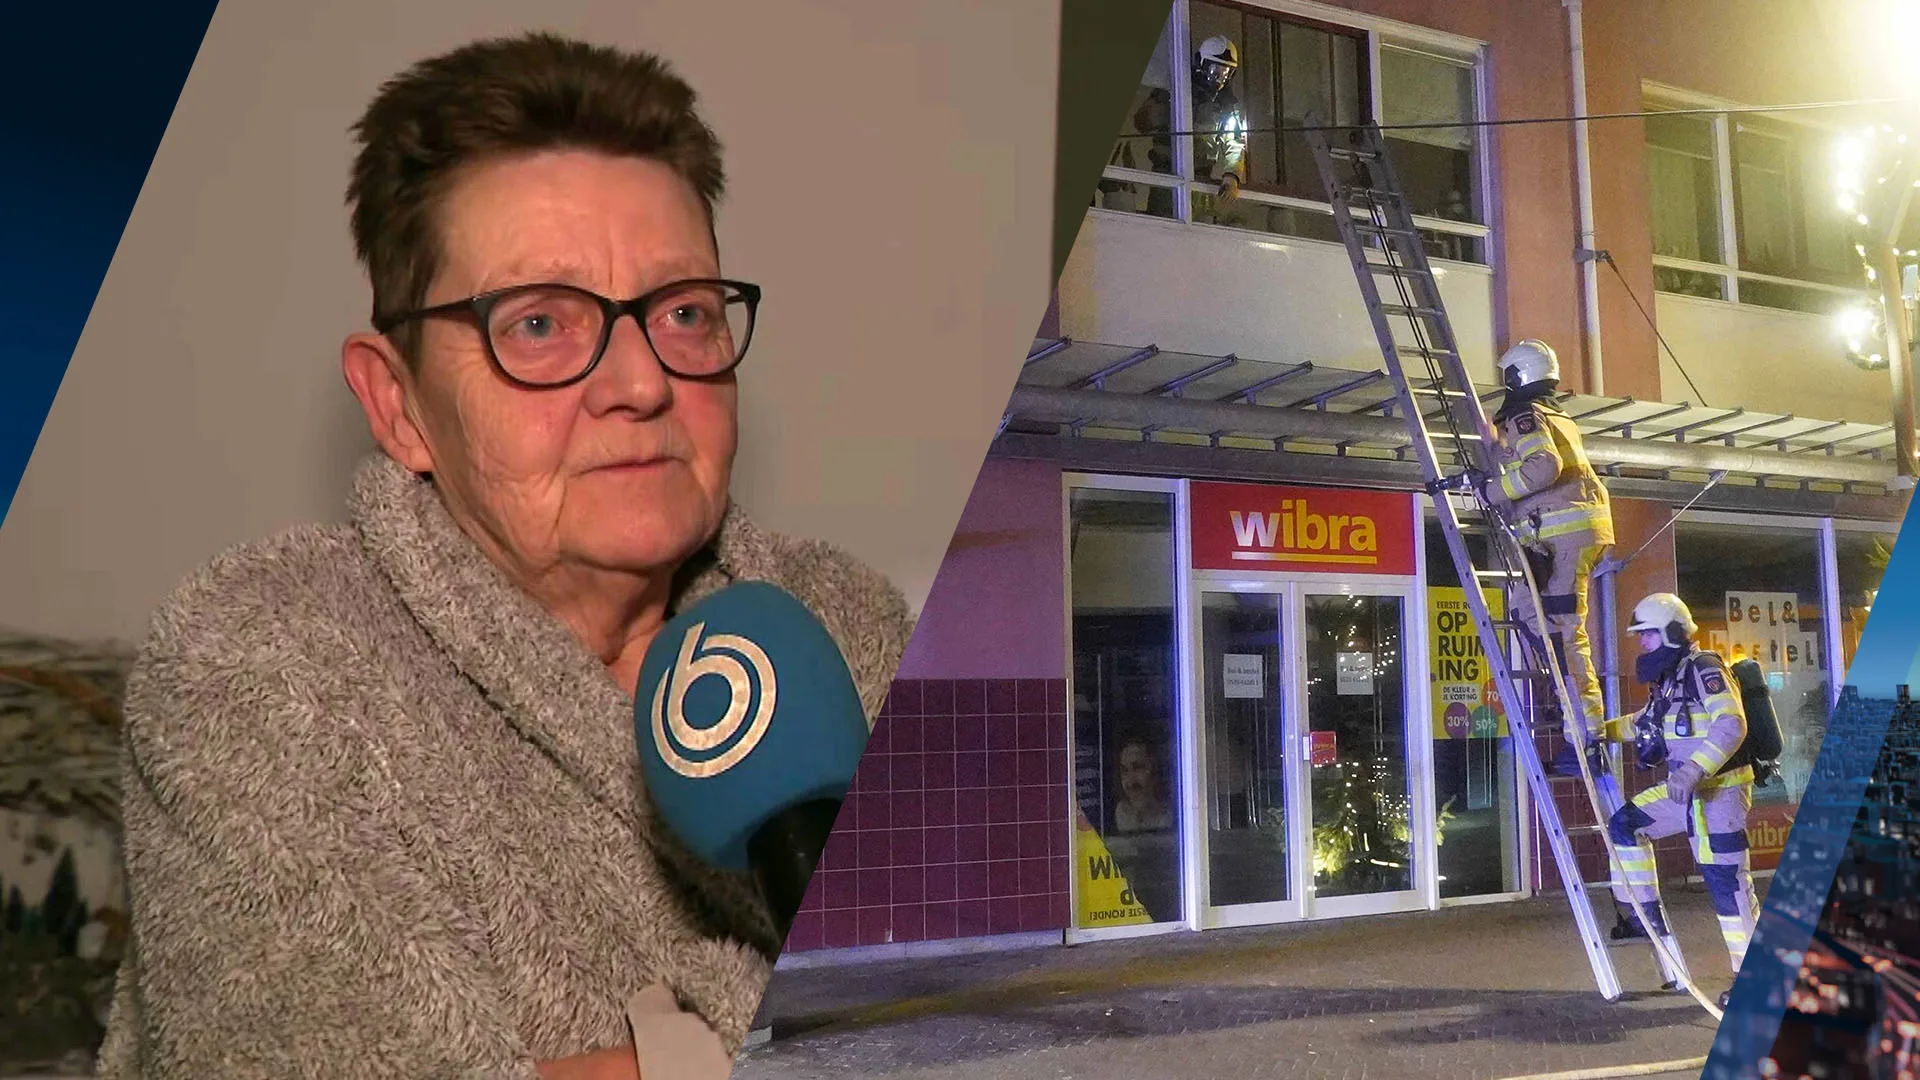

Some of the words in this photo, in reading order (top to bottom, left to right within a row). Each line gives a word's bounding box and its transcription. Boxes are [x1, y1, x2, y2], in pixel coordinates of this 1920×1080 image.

[1229, 499, 1377, 551] wibra
[1436, 601, 1460, 610] EERSTE
[1437, 611, 1468, 633] OP
[1438, 659, 1479, 682] ING
[1486, 690, 1499, 702] 70
[1447, 716, 1470, 727] 30%
[1475, 718, 1497, 730] 50%
[1748, 820, 1792, 847] ibr
